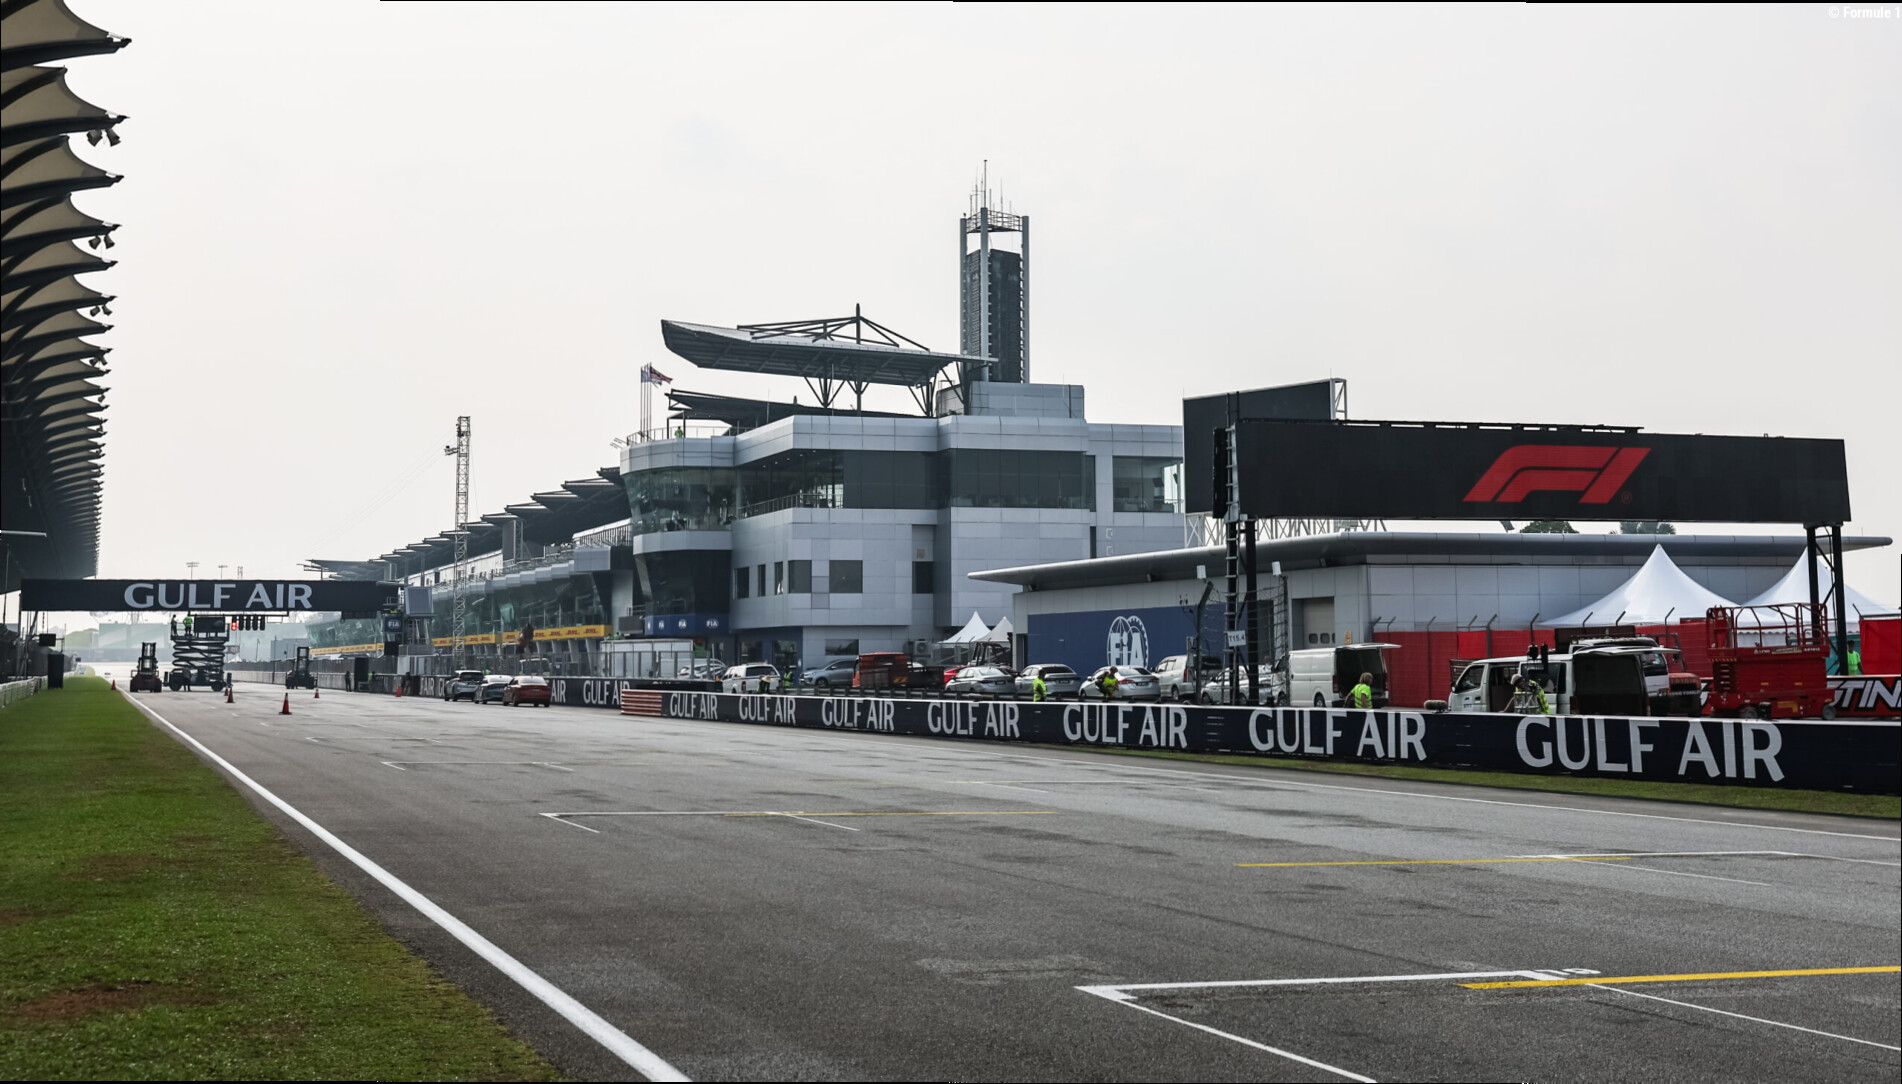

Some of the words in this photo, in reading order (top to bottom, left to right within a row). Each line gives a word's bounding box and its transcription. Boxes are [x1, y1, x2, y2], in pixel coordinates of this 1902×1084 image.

[124, 583, 236, 609] GULF
[245, 583, 313, 609] AIR
[1110, 632, 1145, 666] FIA
[551, 679, 566, 703] AIR
[583, 680, 610, 705] GULF
[670, 693, 697, 718] GULF
[699, 694, 718, 720] AIR
[739, 696, 770, 722] GULF
[774, 697, 796, 724] AIR
[822, 699, 864, 728] GULF
[867, 700, 895, 731] AIR
[927, 702, 979, 735] GULF
[984, 703, 1020, 738] AIR
[1063, 704, 1136, 744] GULF
[1139, 705, 1188, 748] AIR
[1249, 708, 1348, 755] GULF
[1357, 710, 1428, 761] AIR
[1515, 716, 1661, 773] GULF
[1678, 721, 1785, 782] AIR
